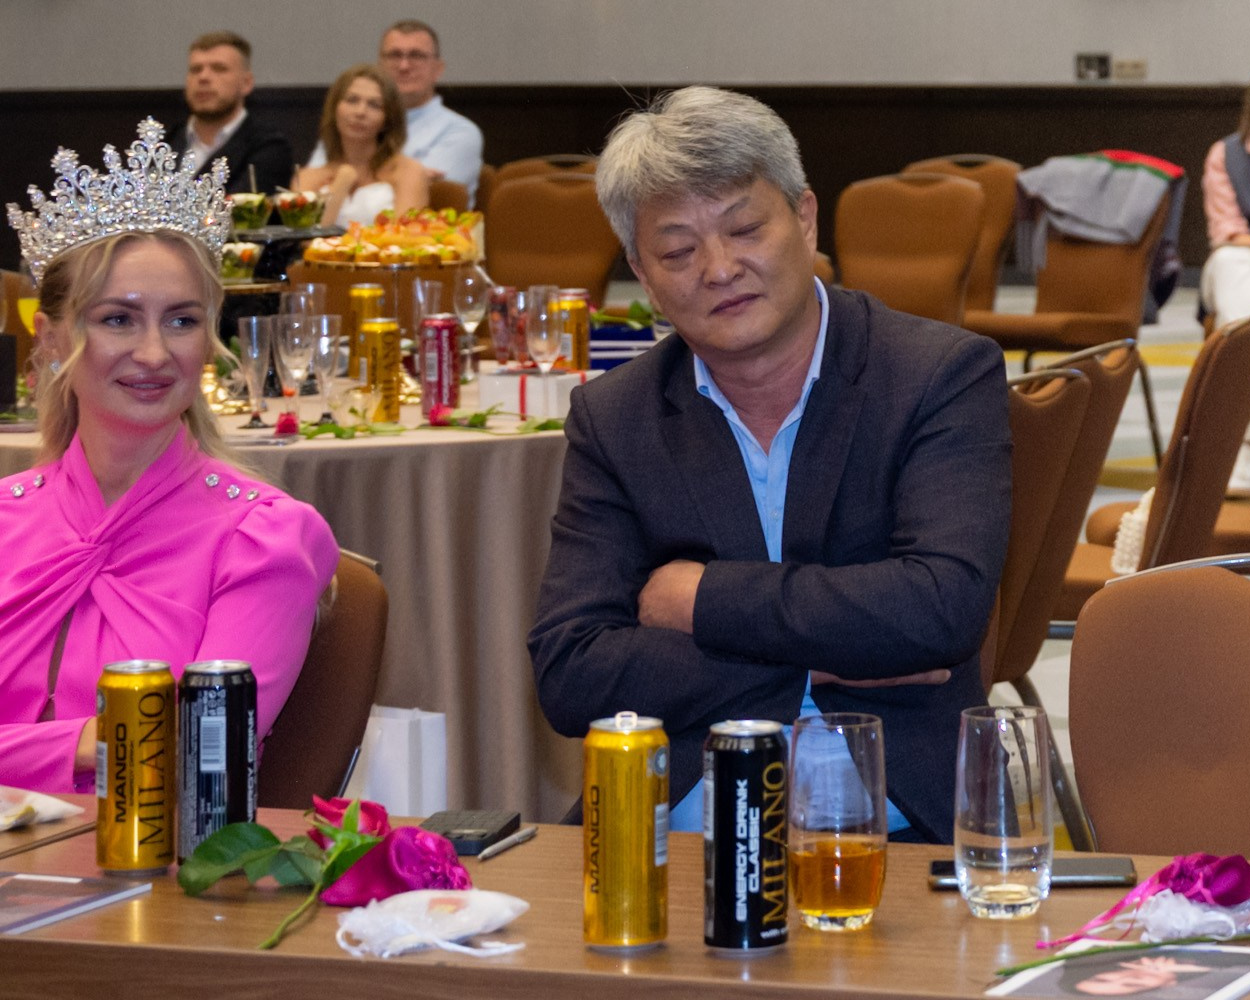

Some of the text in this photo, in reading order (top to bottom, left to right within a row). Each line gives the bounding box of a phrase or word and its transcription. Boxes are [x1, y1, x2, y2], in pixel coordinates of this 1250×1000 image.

[114, 722, 128, 823] MANGO
[138, 691, 166, 847] MILANO
[246, 767, 255, 824] NERGY
[590, 785, 600, 894] MANGO
[735, 779, 748, 922] ENERGY DRINK
[748, 807, 760, 893] CLASSIC
[762, 761, 786, 925] MILANO
